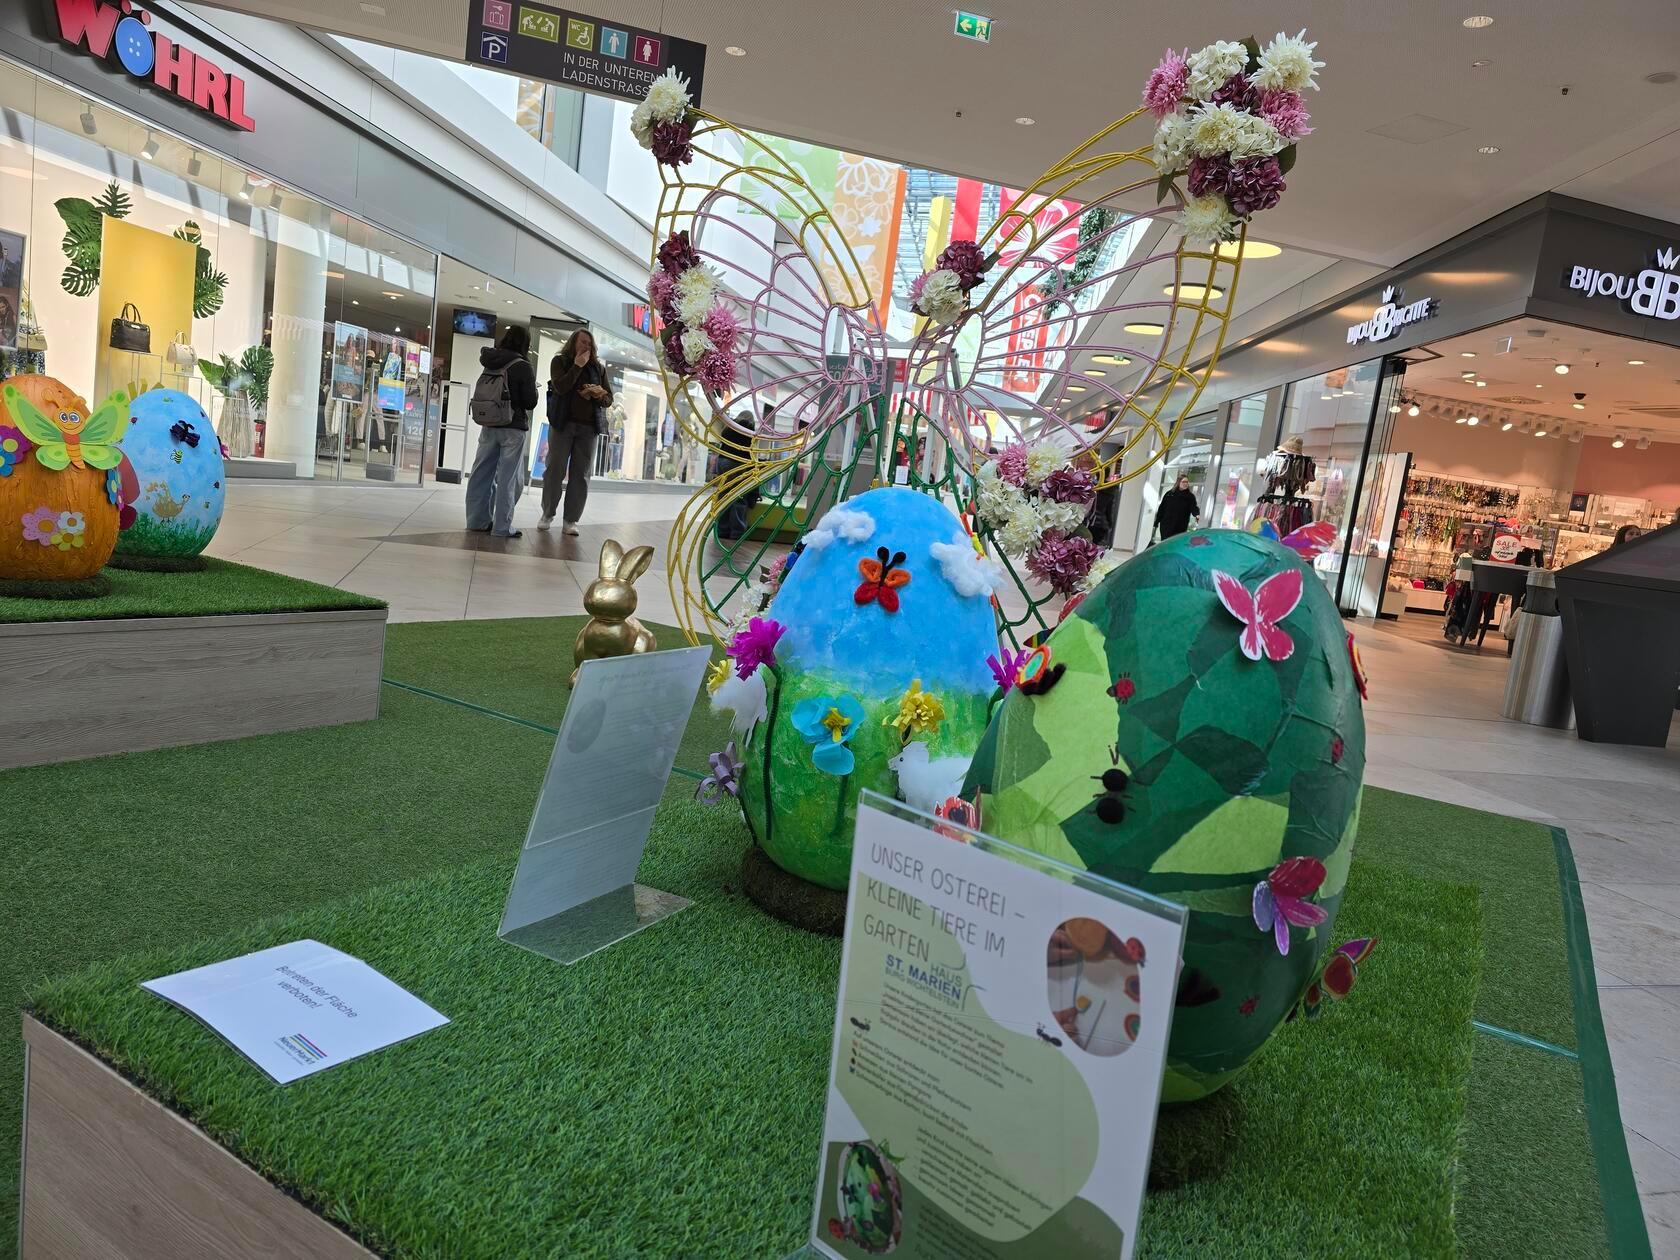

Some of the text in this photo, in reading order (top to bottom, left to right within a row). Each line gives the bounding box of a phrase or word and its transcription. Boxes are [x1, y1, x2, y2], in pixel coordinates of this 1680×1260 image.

[53, 0, 255, 132] WÖHRL
[562, 68, 649, 97] LADENSTRASS
[563, 52, 658, 83] IN DER UNTEREN
[1570, 265, 1635, 299] BIJOU
[1014, 293, 1042, 384] CINEPEX
[871, 843, 924, 885] UNSER
[931, 871, 1006, 918] OSTEREI
[863, 914, 931, 963] GARTEN
[867, 878, 1006, 958] KLEINE TIERE IM
[275, 965, 358, 1018] Betreten der Fläche
[277, 981, 324, 1009] verboten!
[885, 954, 961, 1001] ST. MARIEN
[930, 962, 962, 988] HAUS
